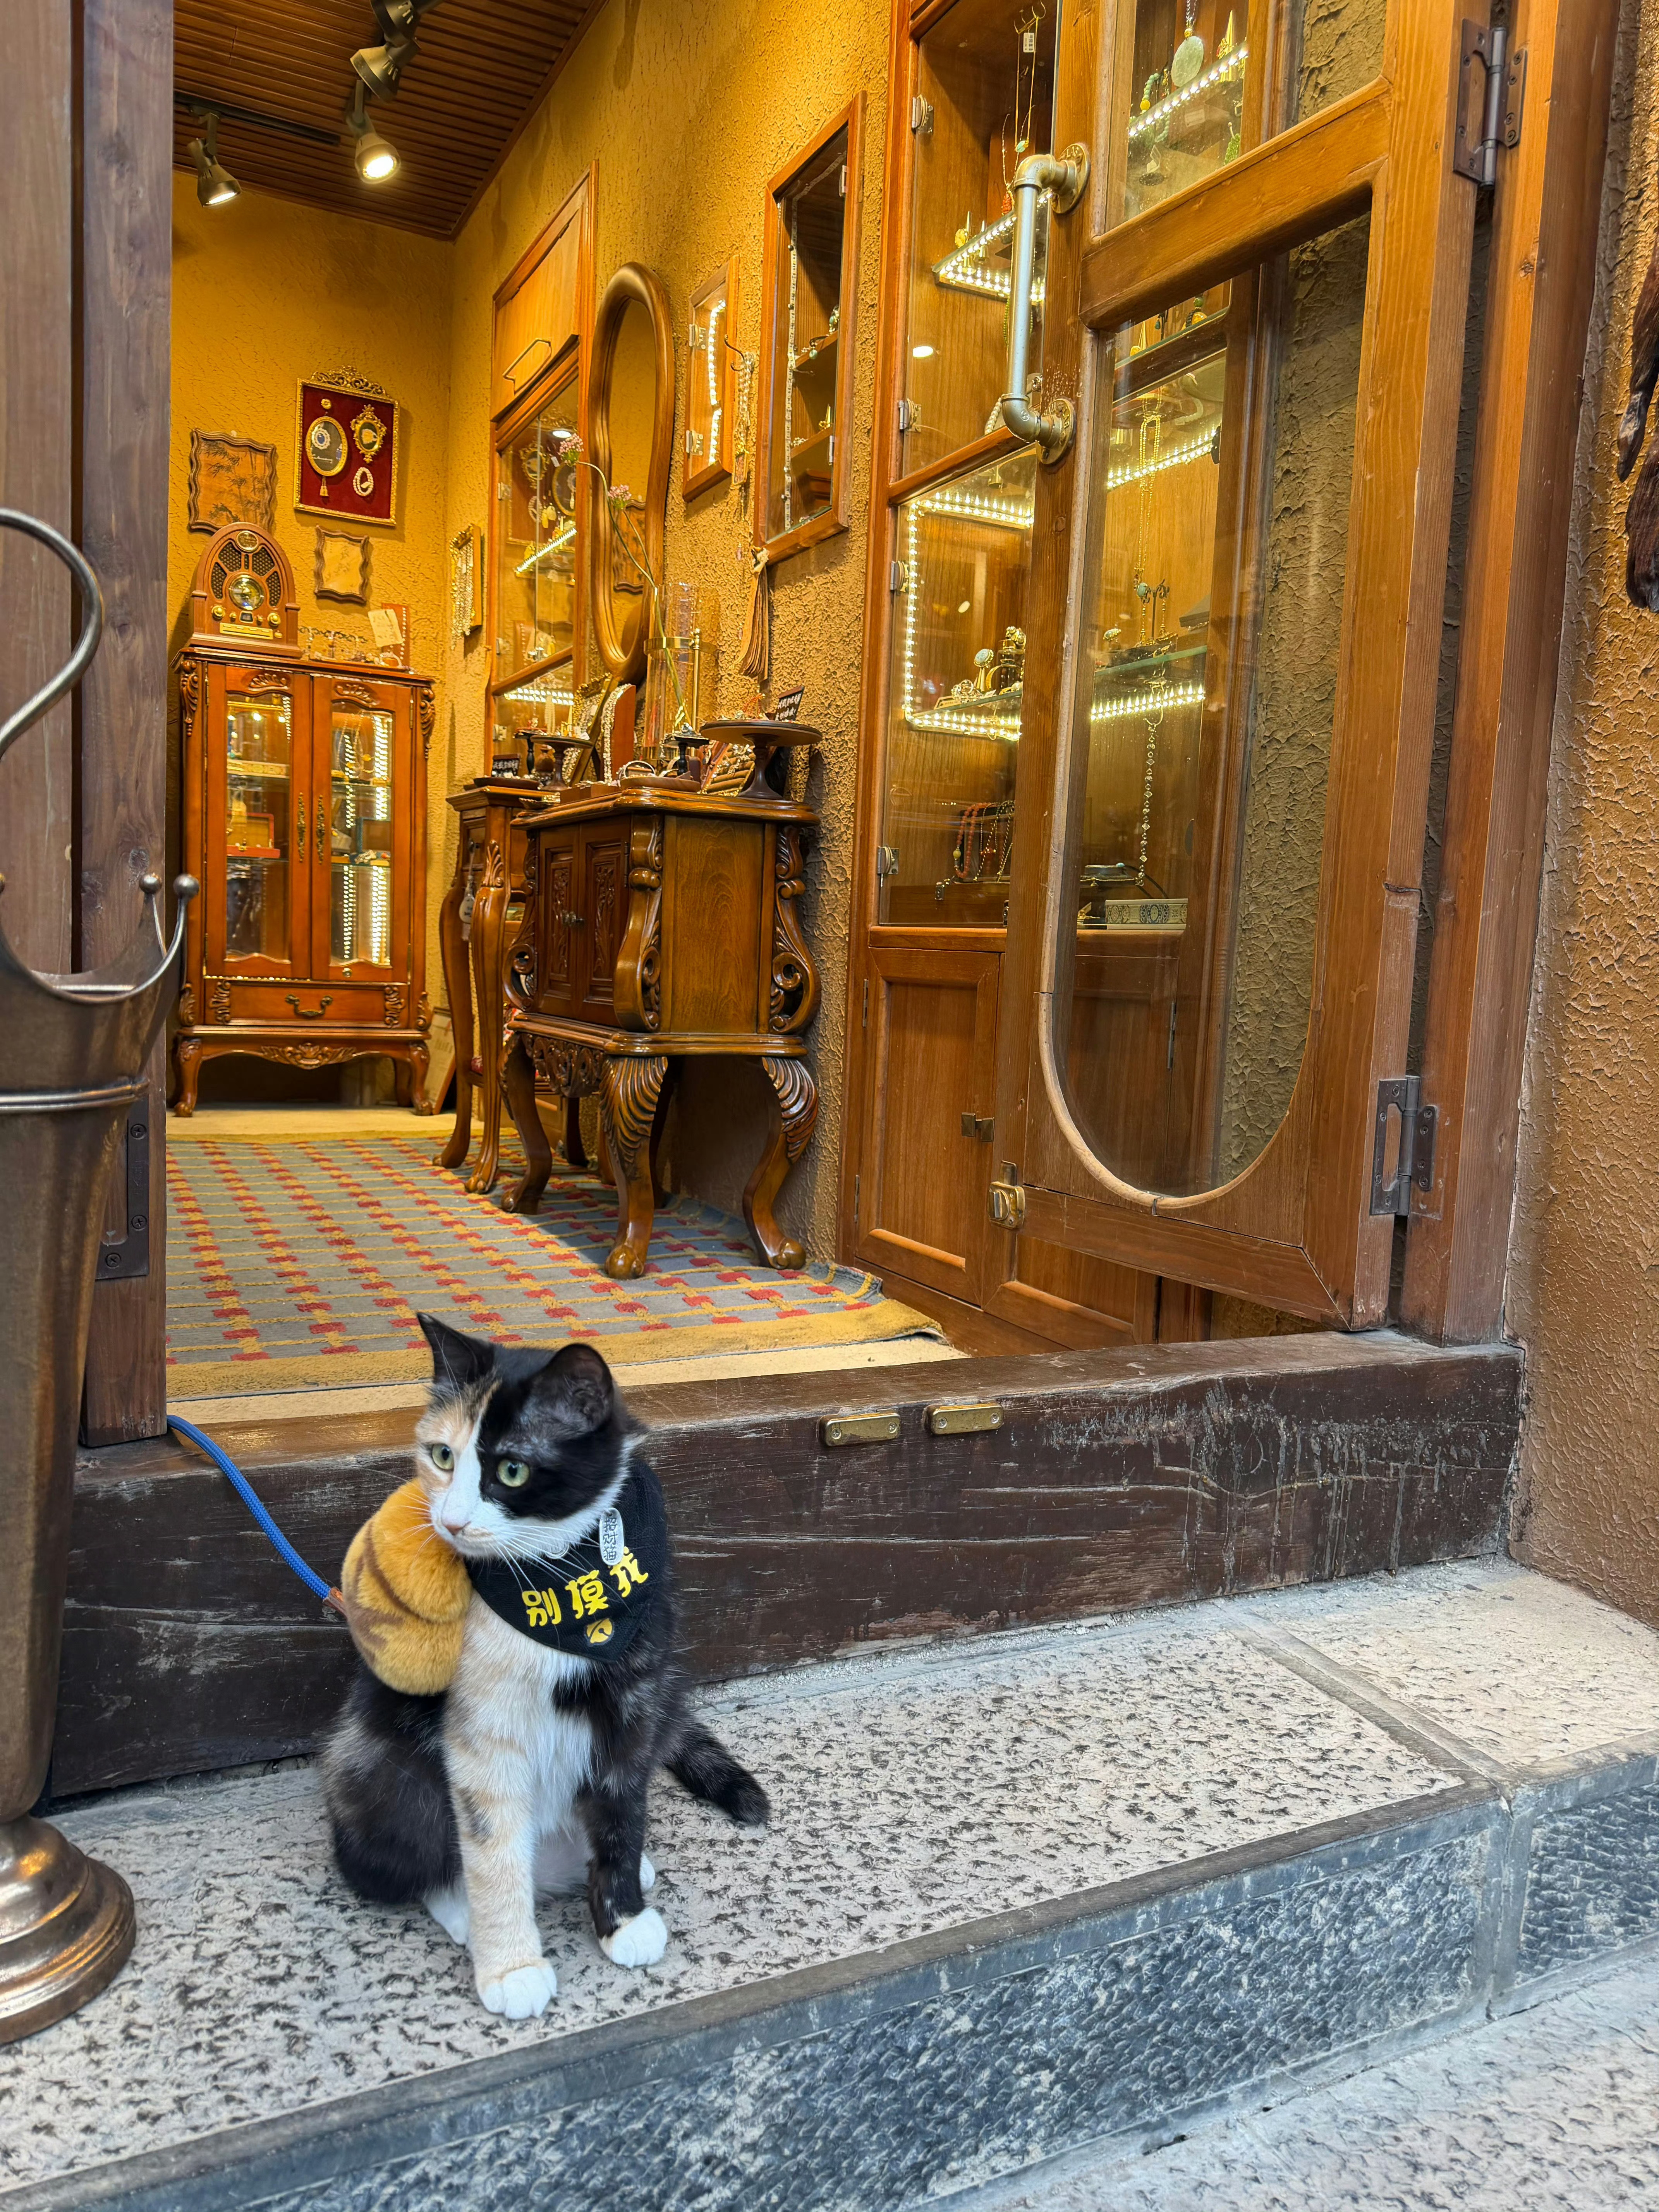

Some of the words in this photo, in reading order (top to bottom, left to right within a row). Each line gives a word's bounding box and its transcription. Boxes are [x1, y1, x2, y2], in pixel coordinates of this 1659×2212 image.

[602, 1517, 618, 1561] 招财猫
[521, 1546, 649, 1627] 别摸我
